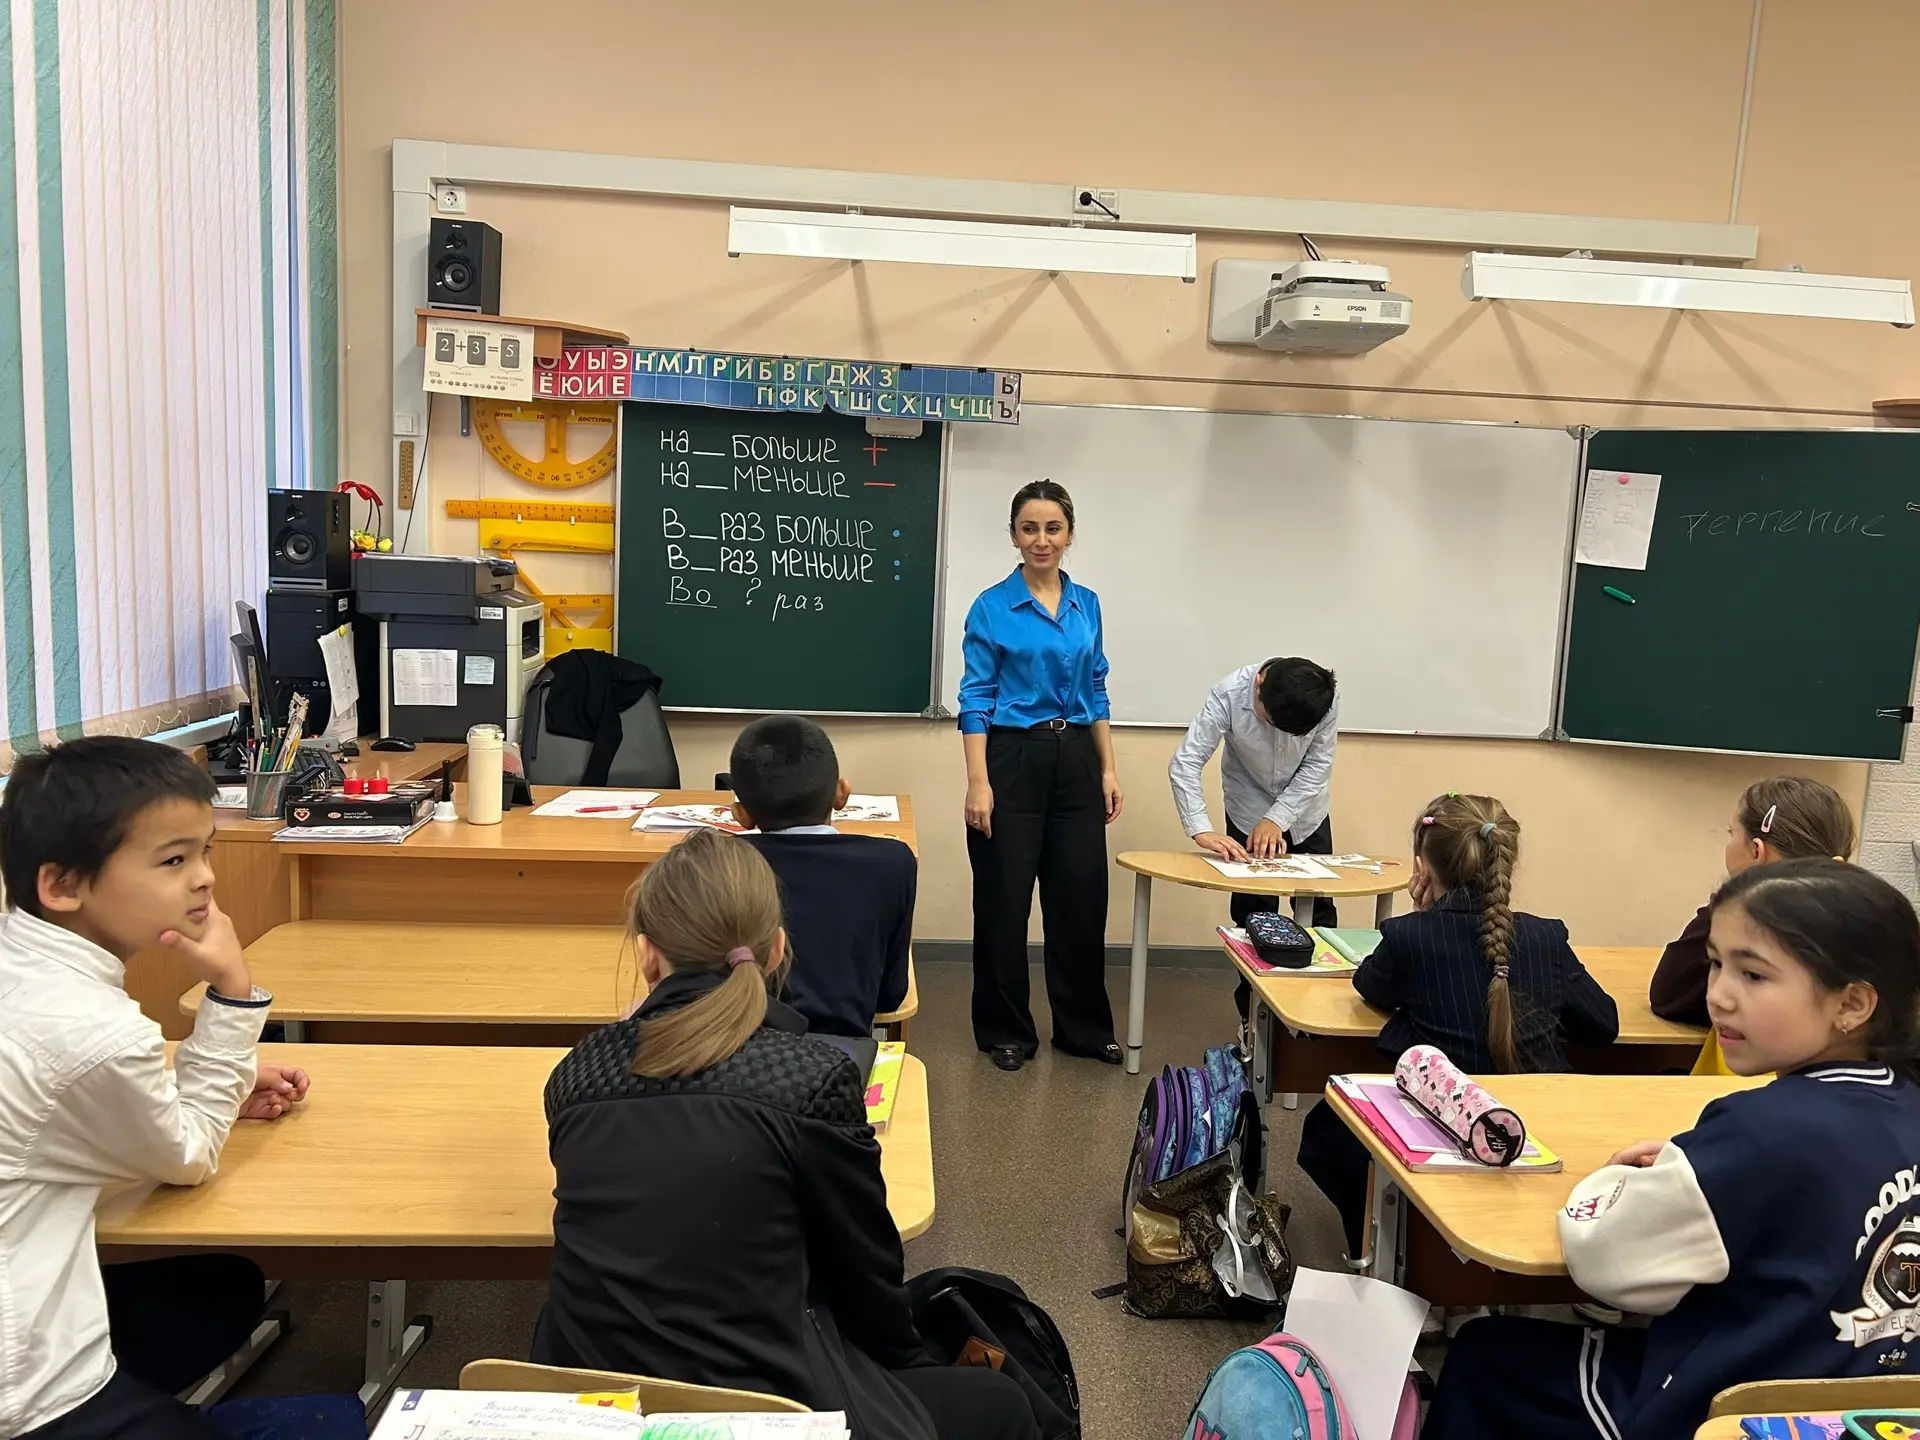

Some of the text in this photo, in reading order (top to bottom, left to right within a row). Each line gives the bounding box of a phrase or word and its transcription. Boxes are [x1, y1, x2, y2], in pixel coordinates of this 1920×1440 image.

[440, 338, 450, 352] 2
[472, 341, 481, 354] 3
[506, 344, 514, 357] 5
[671, 576, 824, 622] Во ? раз
